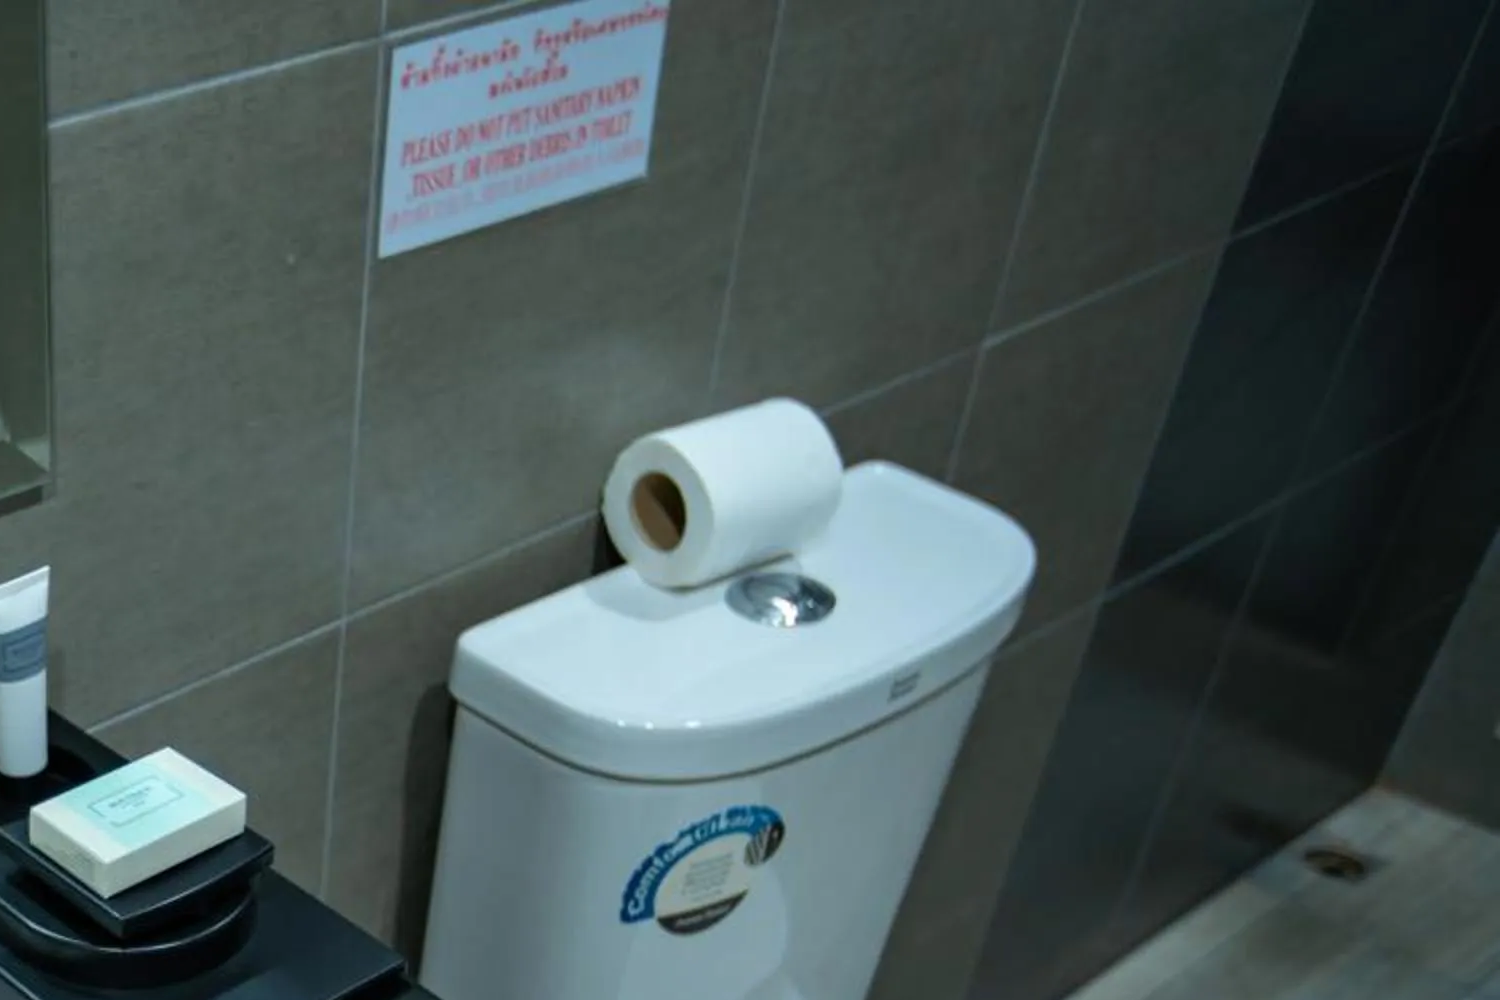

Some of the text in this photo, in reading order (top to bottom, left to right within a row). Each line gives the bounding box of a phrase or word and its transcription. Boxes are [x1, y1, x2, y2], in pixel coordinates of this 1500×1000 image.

[402, 129, 453, 168] PLEASE
[455, 123, 475, 152] DO
[478, 114, 504, 141] NOT
[506, 106, 531, 138] PUT
